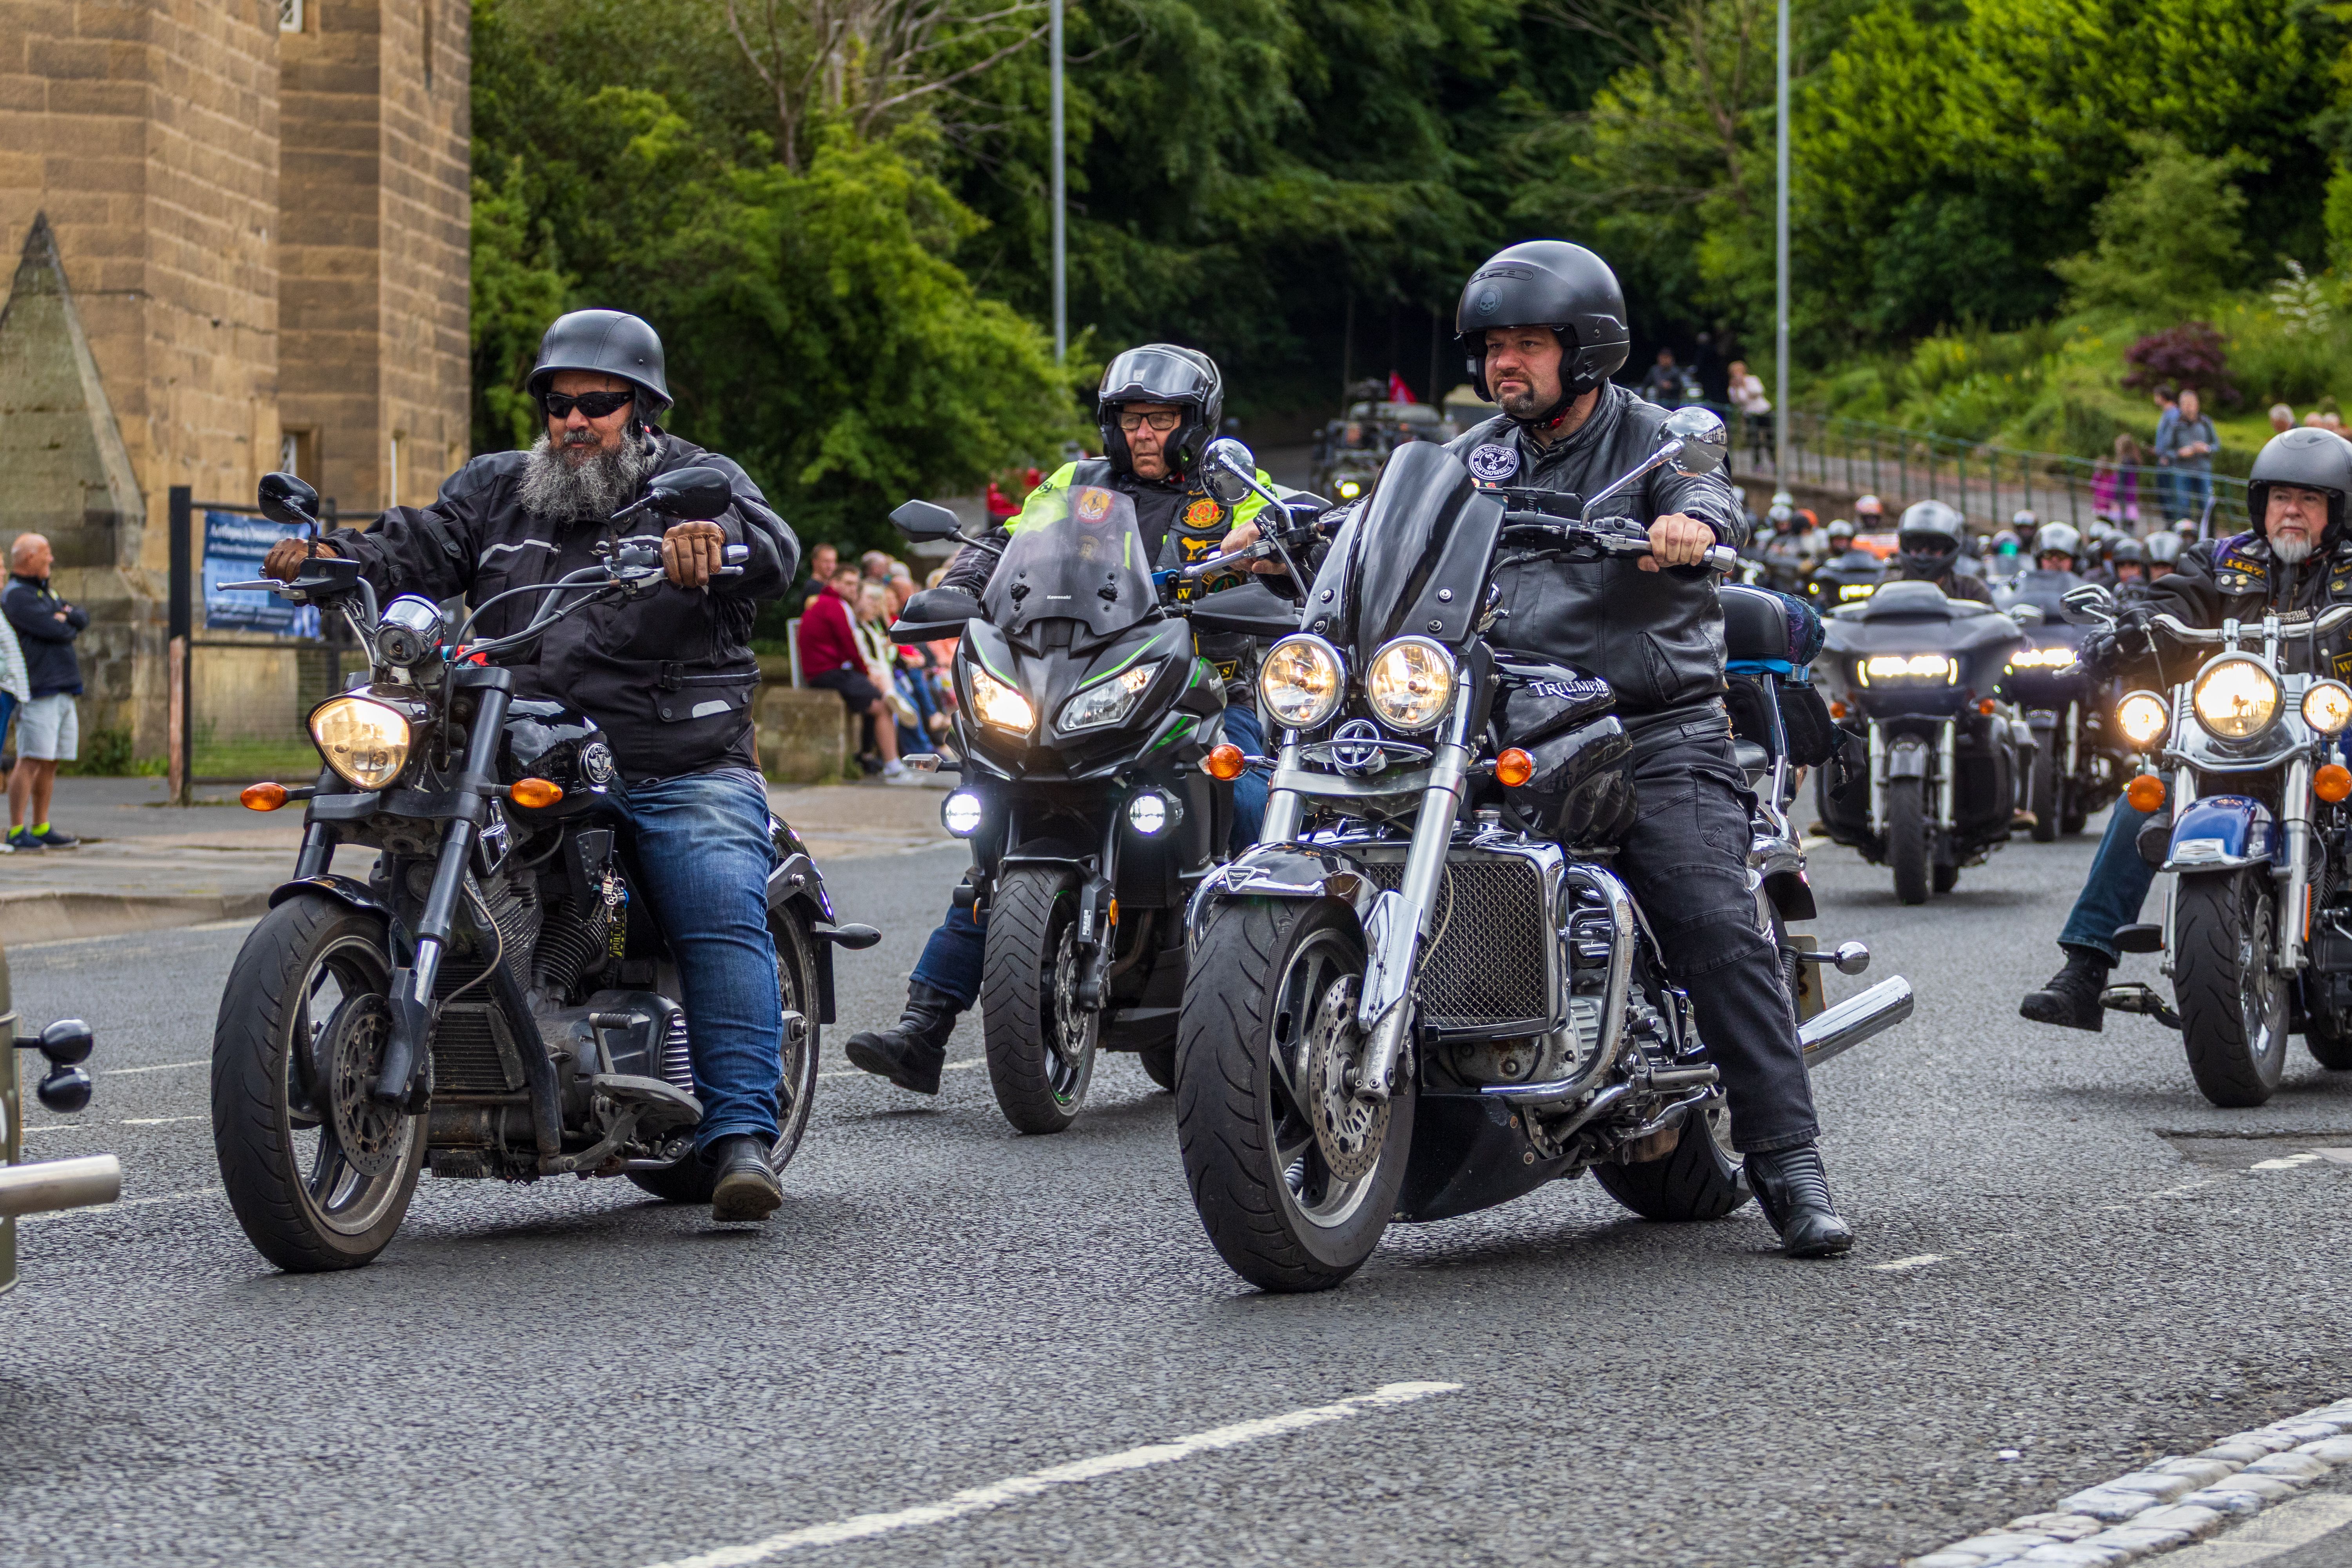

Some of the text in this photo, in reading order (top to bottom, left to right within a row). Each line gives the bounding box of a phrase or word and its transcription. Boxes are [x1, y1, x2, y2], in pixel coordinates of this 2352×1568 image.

[1474, 449, 1485, 459] THE
[1504, 450, 1515, 465] WATCH
[1474, 461, 1512, 476] NORTHUMBRIA
[2225, 559, 2265, 578] 1427
[1528, 681, 1605, 701] TRIUMPH
[590, 746, 609, 757] VICTORY
[794, 1095, 810, 1139] COBRA
